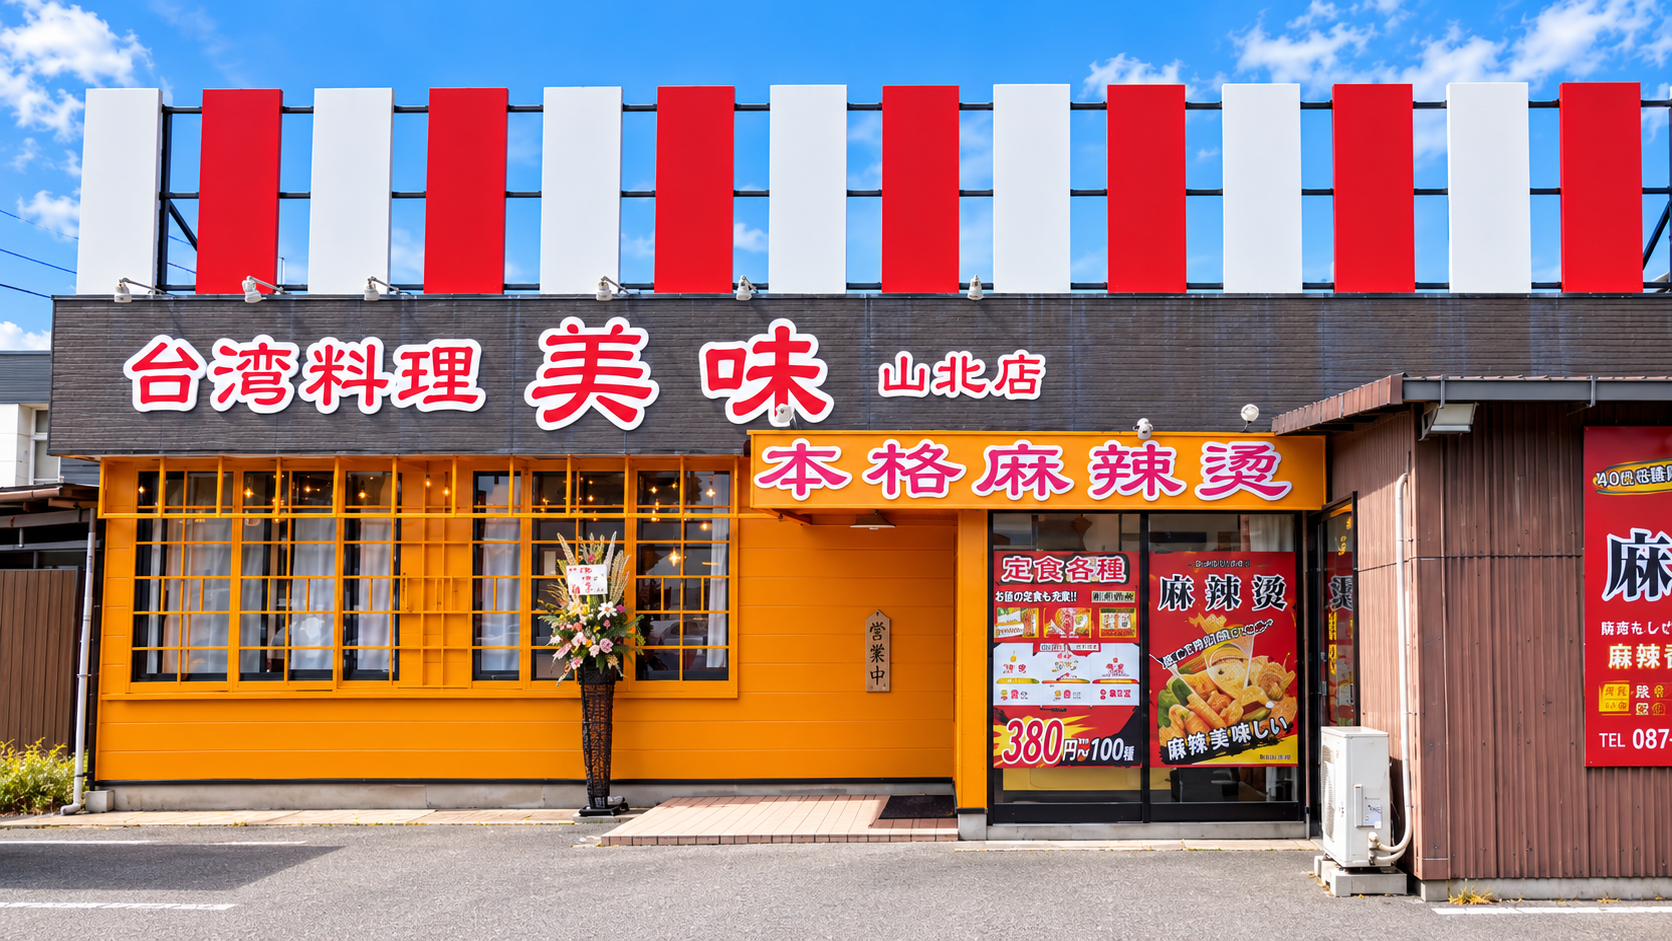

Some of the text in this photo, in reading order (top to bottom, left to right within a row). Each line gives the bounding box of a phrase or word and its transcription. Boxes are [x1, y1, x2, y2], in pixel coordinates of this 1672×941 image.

[125, 318, 1046, 430] 台湾料理 美味 山北店
[1001, 555, 1126, 583] 定食各種
[869, 621, 886, 686] 営業中
[1599, 733, 1626, 748] TEL
